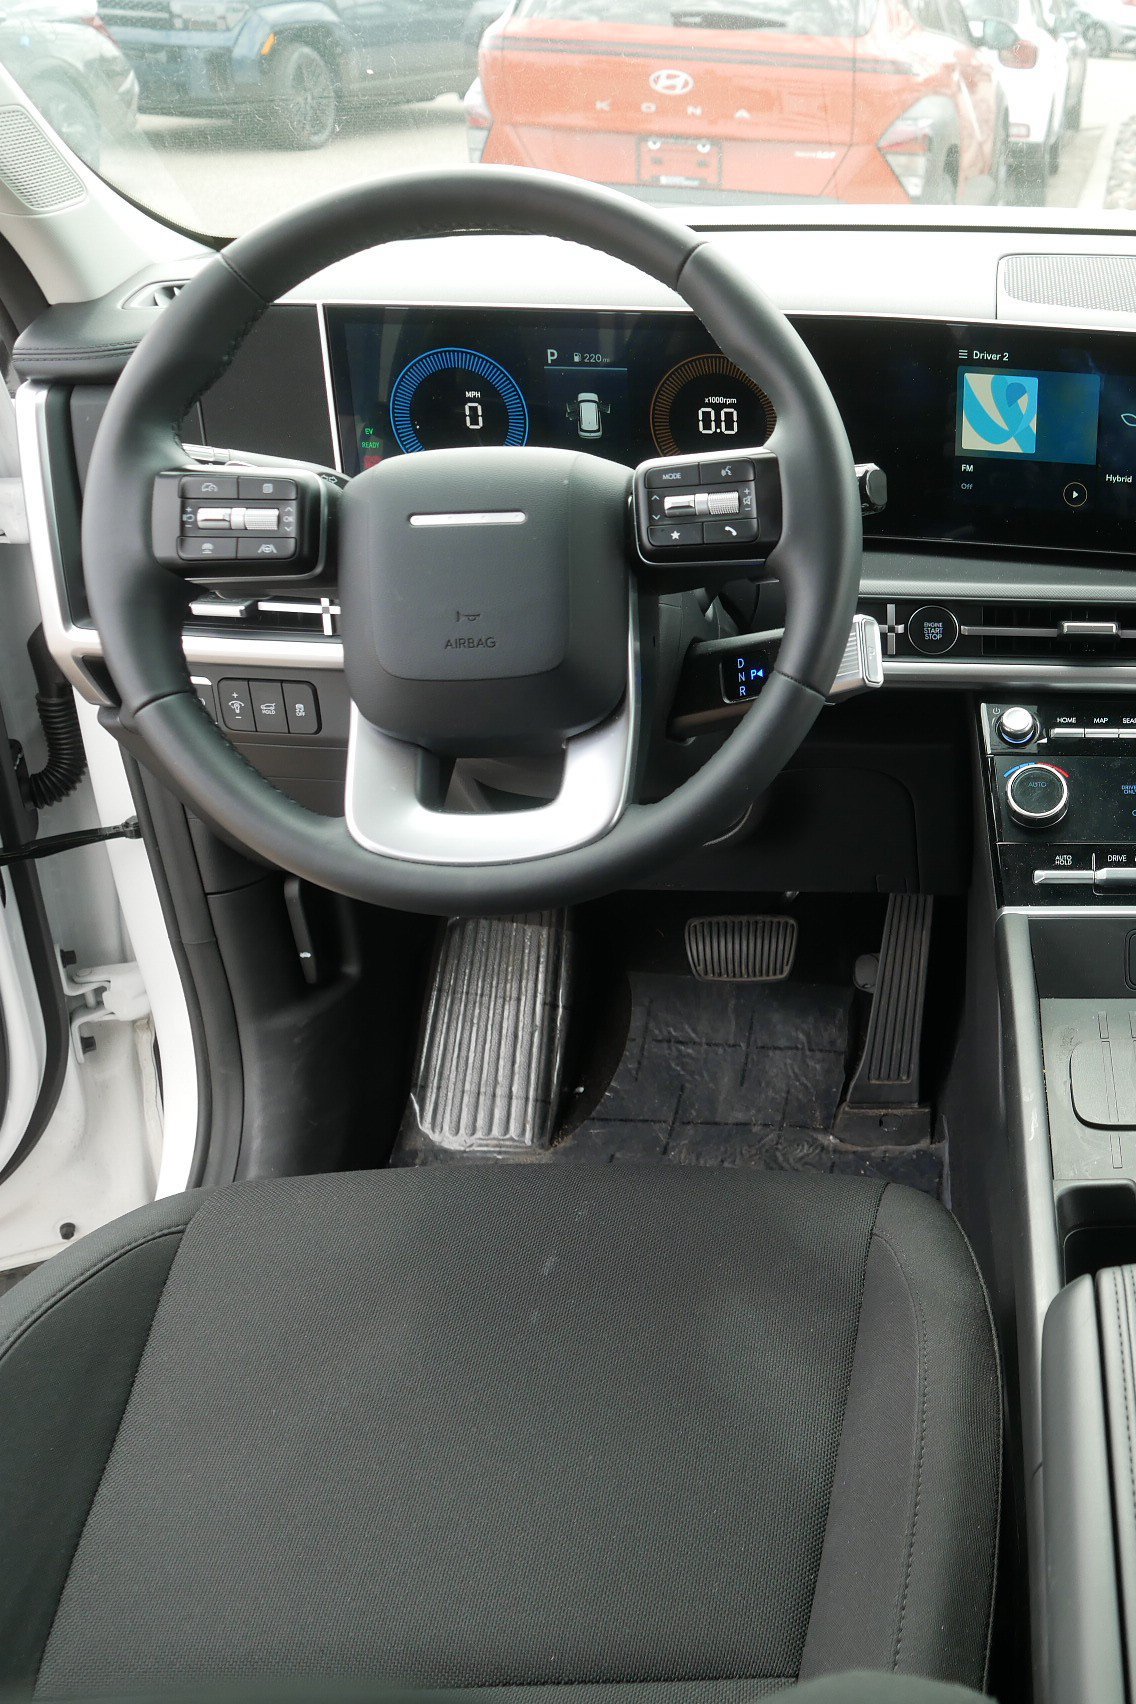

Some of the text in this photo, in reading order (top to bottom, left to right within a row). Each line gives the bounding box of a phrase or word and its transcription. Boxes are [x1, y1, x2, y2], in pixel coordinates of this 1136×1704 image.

[595, 100, 751, 119] KONA
[547, 349, 558, 364] P
[584, 353, 602, 363] 220
[973, 350, 1009, 361] Driver 2
[704, 396, 737, 405] x1000rpm
[464, 402, 483, 430] 0
[698, 407, 738, 435] 0.0
[361, 441, 380, 449] READY
[961, 464, 974, 472] FM
[662, 472, 681, 480] MODE
[1105, 474, 1133, 484] Hybrid
[960, 482, 973, 490] Off
[282, 515, 294, 523] OK
[444, 637, 496, 650] AIRBAG
[737, 658, 745, 669] D
[738, 669, 757, 682] N P
[739, 685, 746, 696] R
[1107, 854, 1127, 862] DRIVE
